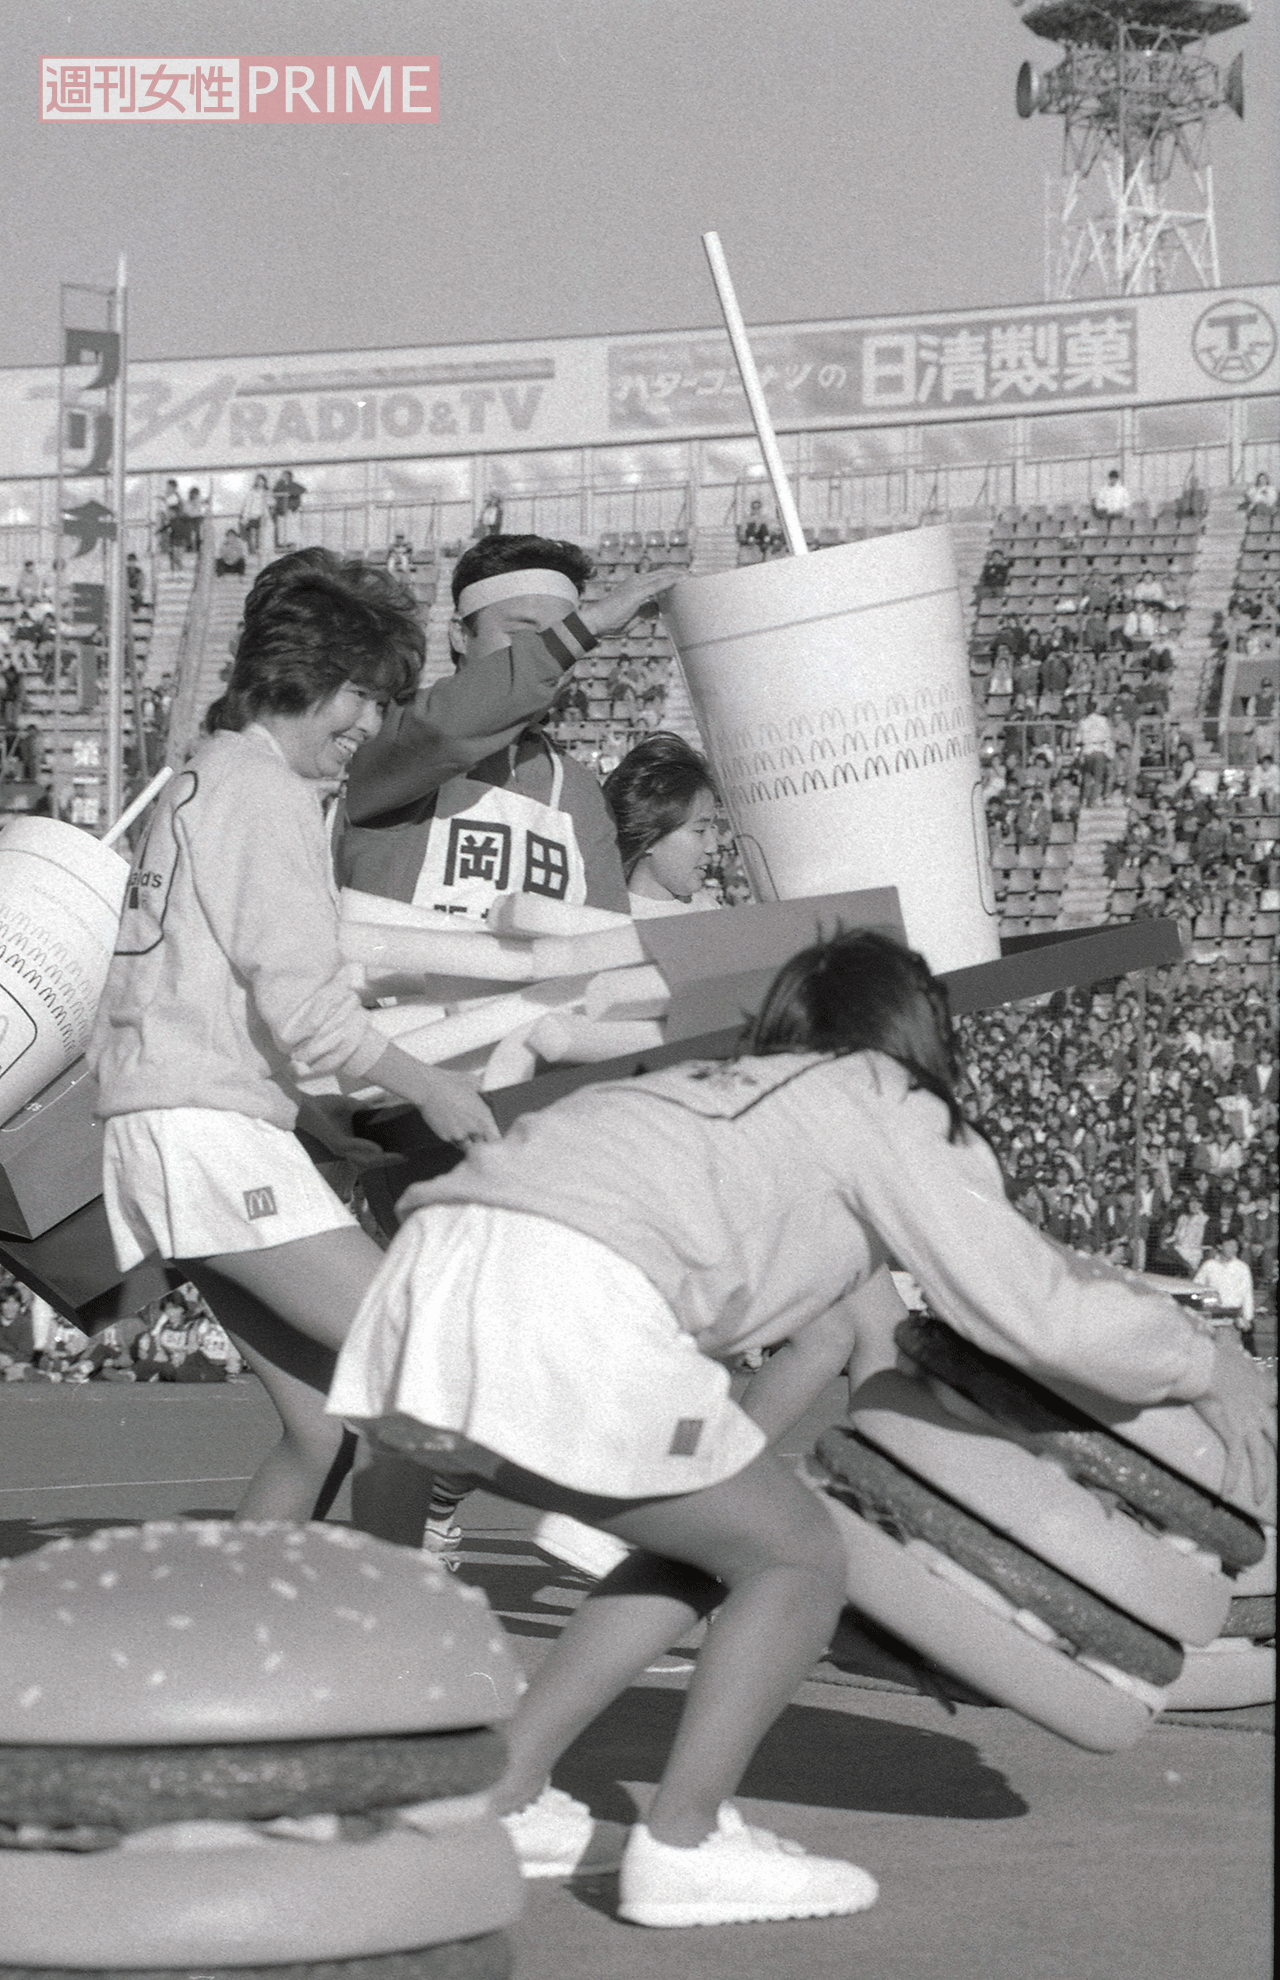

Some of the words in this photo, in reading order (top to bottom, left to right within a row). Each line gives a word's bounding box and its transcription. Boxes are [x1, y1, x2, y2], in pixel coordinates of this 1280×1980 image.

[861, 314, 1136, 406] 日清製菓
[442, 817, 570, 901] 岡田
